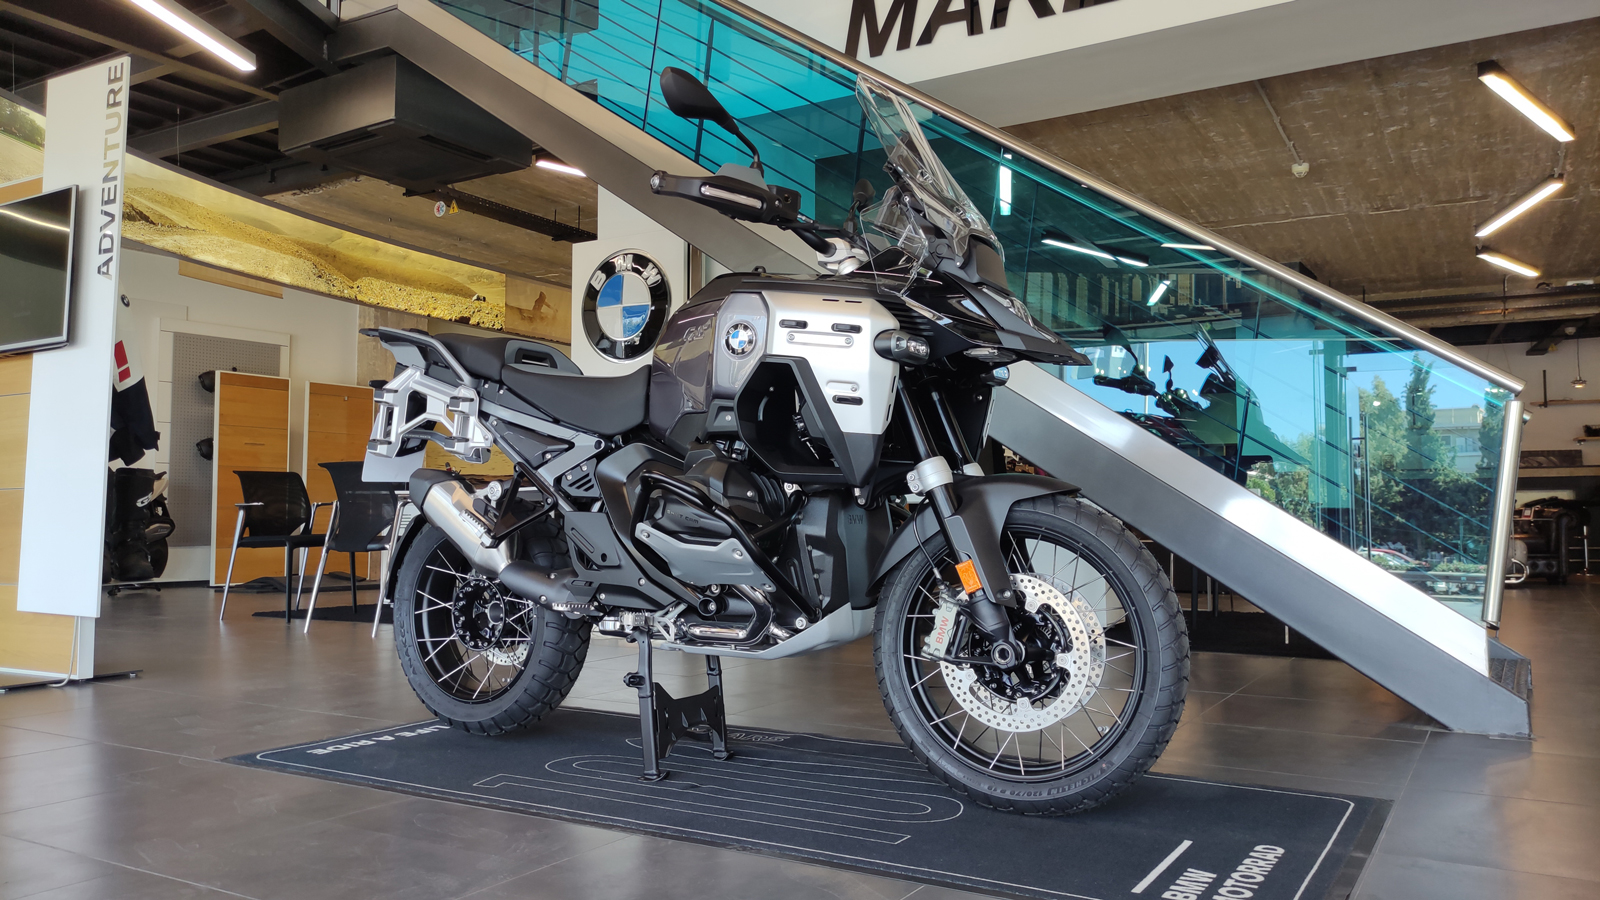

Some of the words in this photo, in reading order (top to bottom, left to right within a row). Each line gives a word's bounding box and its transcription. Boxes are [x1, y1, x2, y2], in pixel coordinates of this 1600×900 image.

[97, 62, 124, 280] ADVENTURE
[590, 254, 662, 291] BMW
[935, 615, 949, 645] BMW
[394, 725, 450, 738] LIFE
[306, 739, 377, 755] RIDE
[1009, 789, 1043, 798] 120/70
[1047, 769, 1102, 796] MICHELIN
[1161, 868, 1217, 900] BMW
[1212, 845, 1285, 900] OTORRAD
